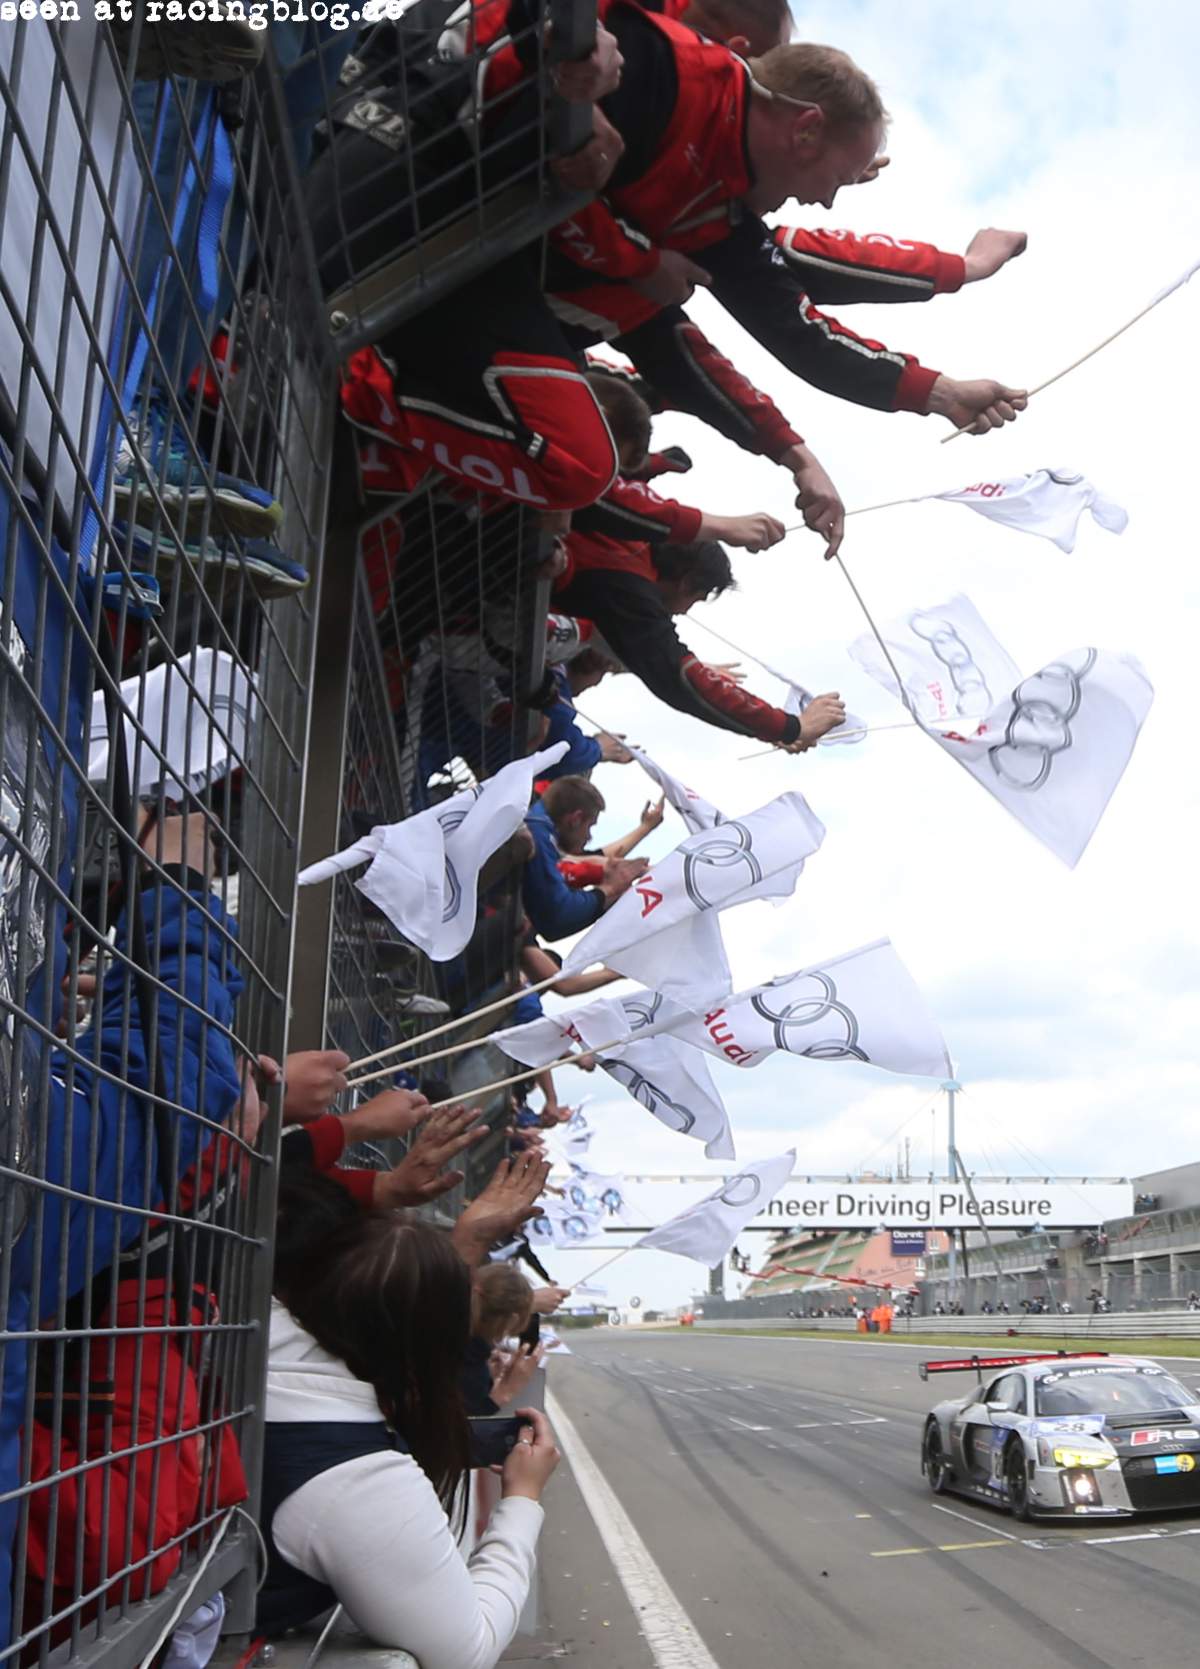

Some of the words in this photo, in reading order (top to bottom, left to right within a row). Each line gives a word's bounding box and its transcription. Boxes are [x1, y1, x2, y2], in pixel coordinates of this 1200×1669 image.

[836, 1194, 931, 1221] Driving
[939, 1194, 1052, 1216] Pleasure
[1054, 1423, 1085, 1432] 28
